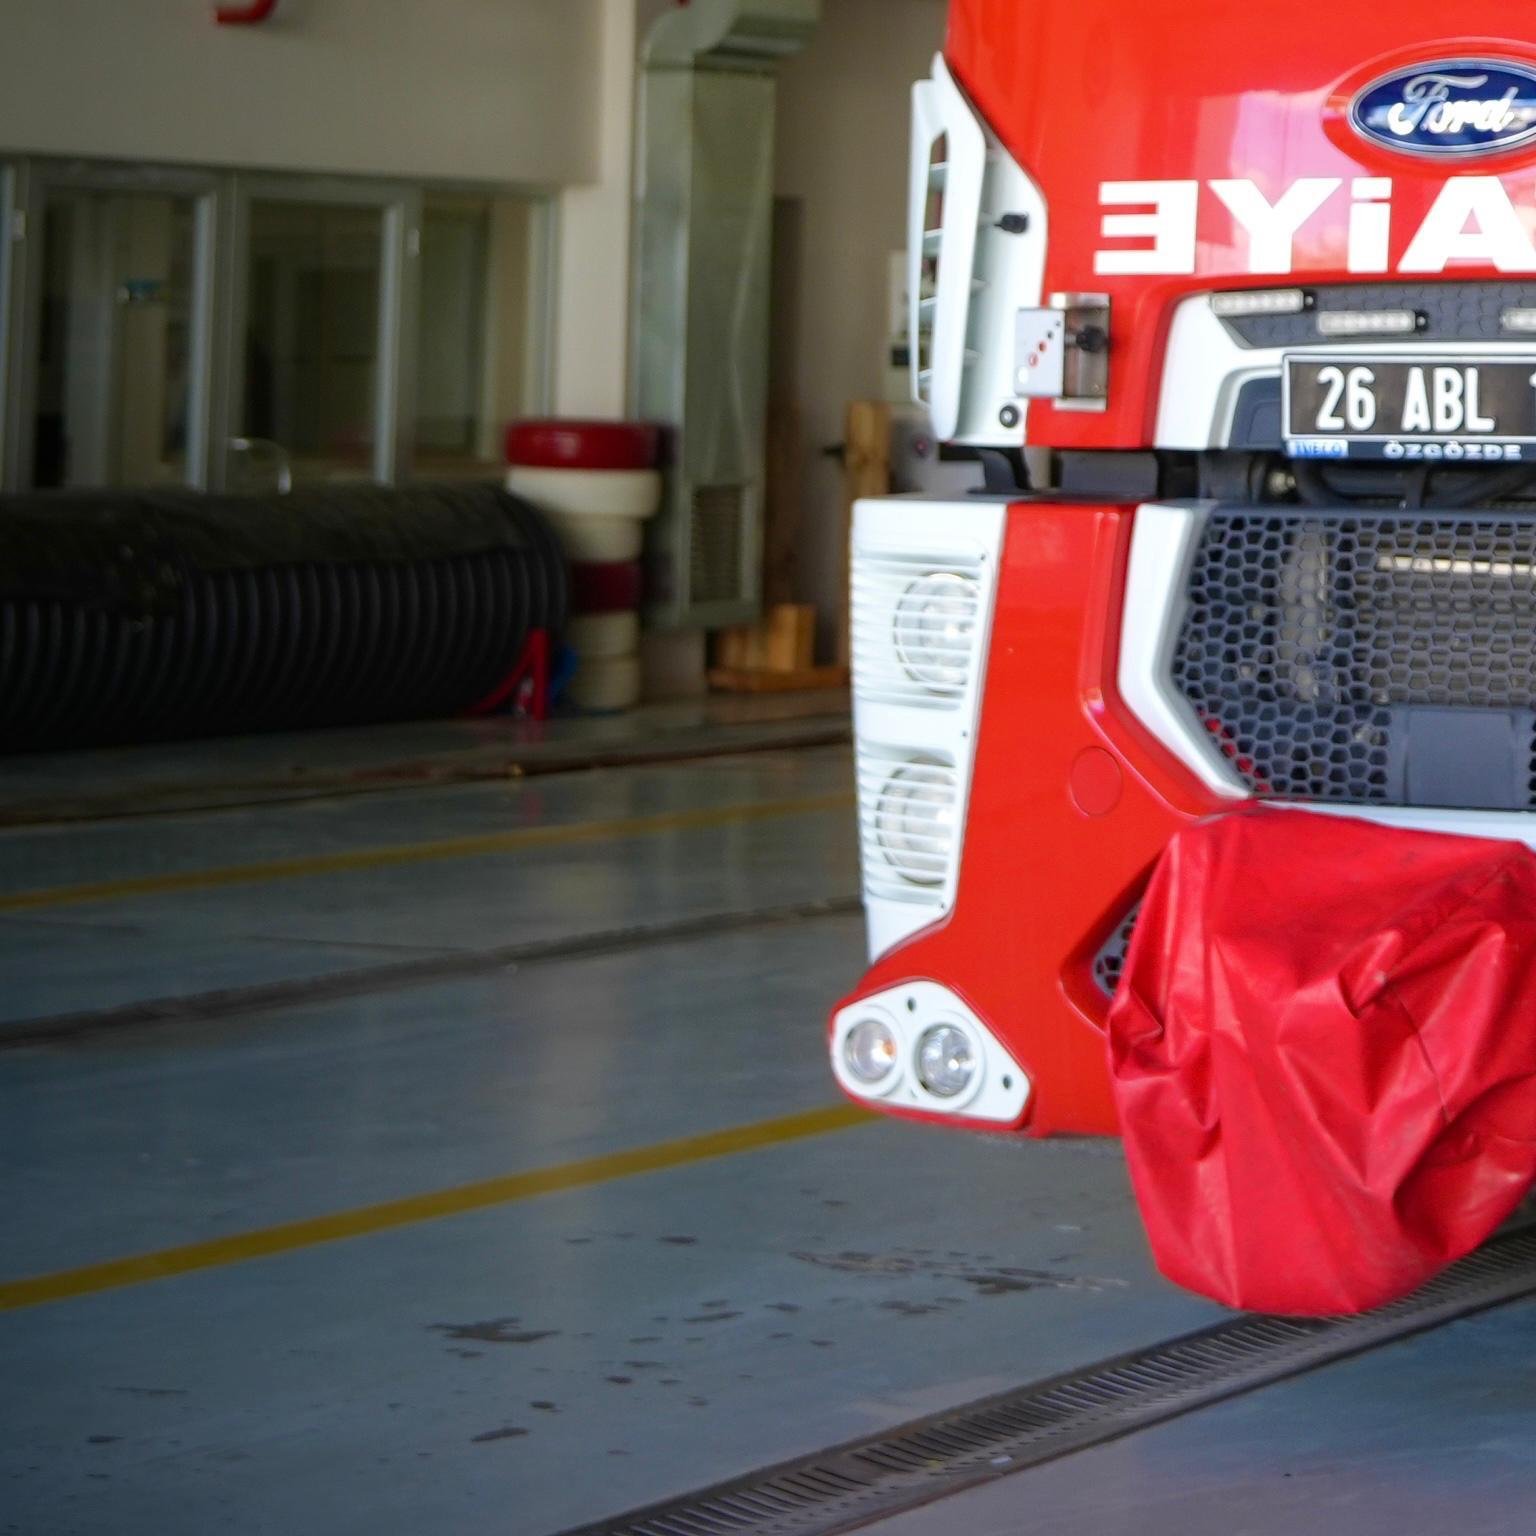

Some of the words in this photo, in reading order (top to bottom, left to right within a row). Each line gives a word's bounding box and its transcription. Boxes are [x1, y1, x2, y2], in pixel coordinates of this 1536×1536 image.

[1388, 74, 1520, 135] Ford
[1315, 366, 1376, 432] 26
[1401, 366, 1496, 432] ABL
[1383, 439, 1522, 460] ÖZGÖZDE
